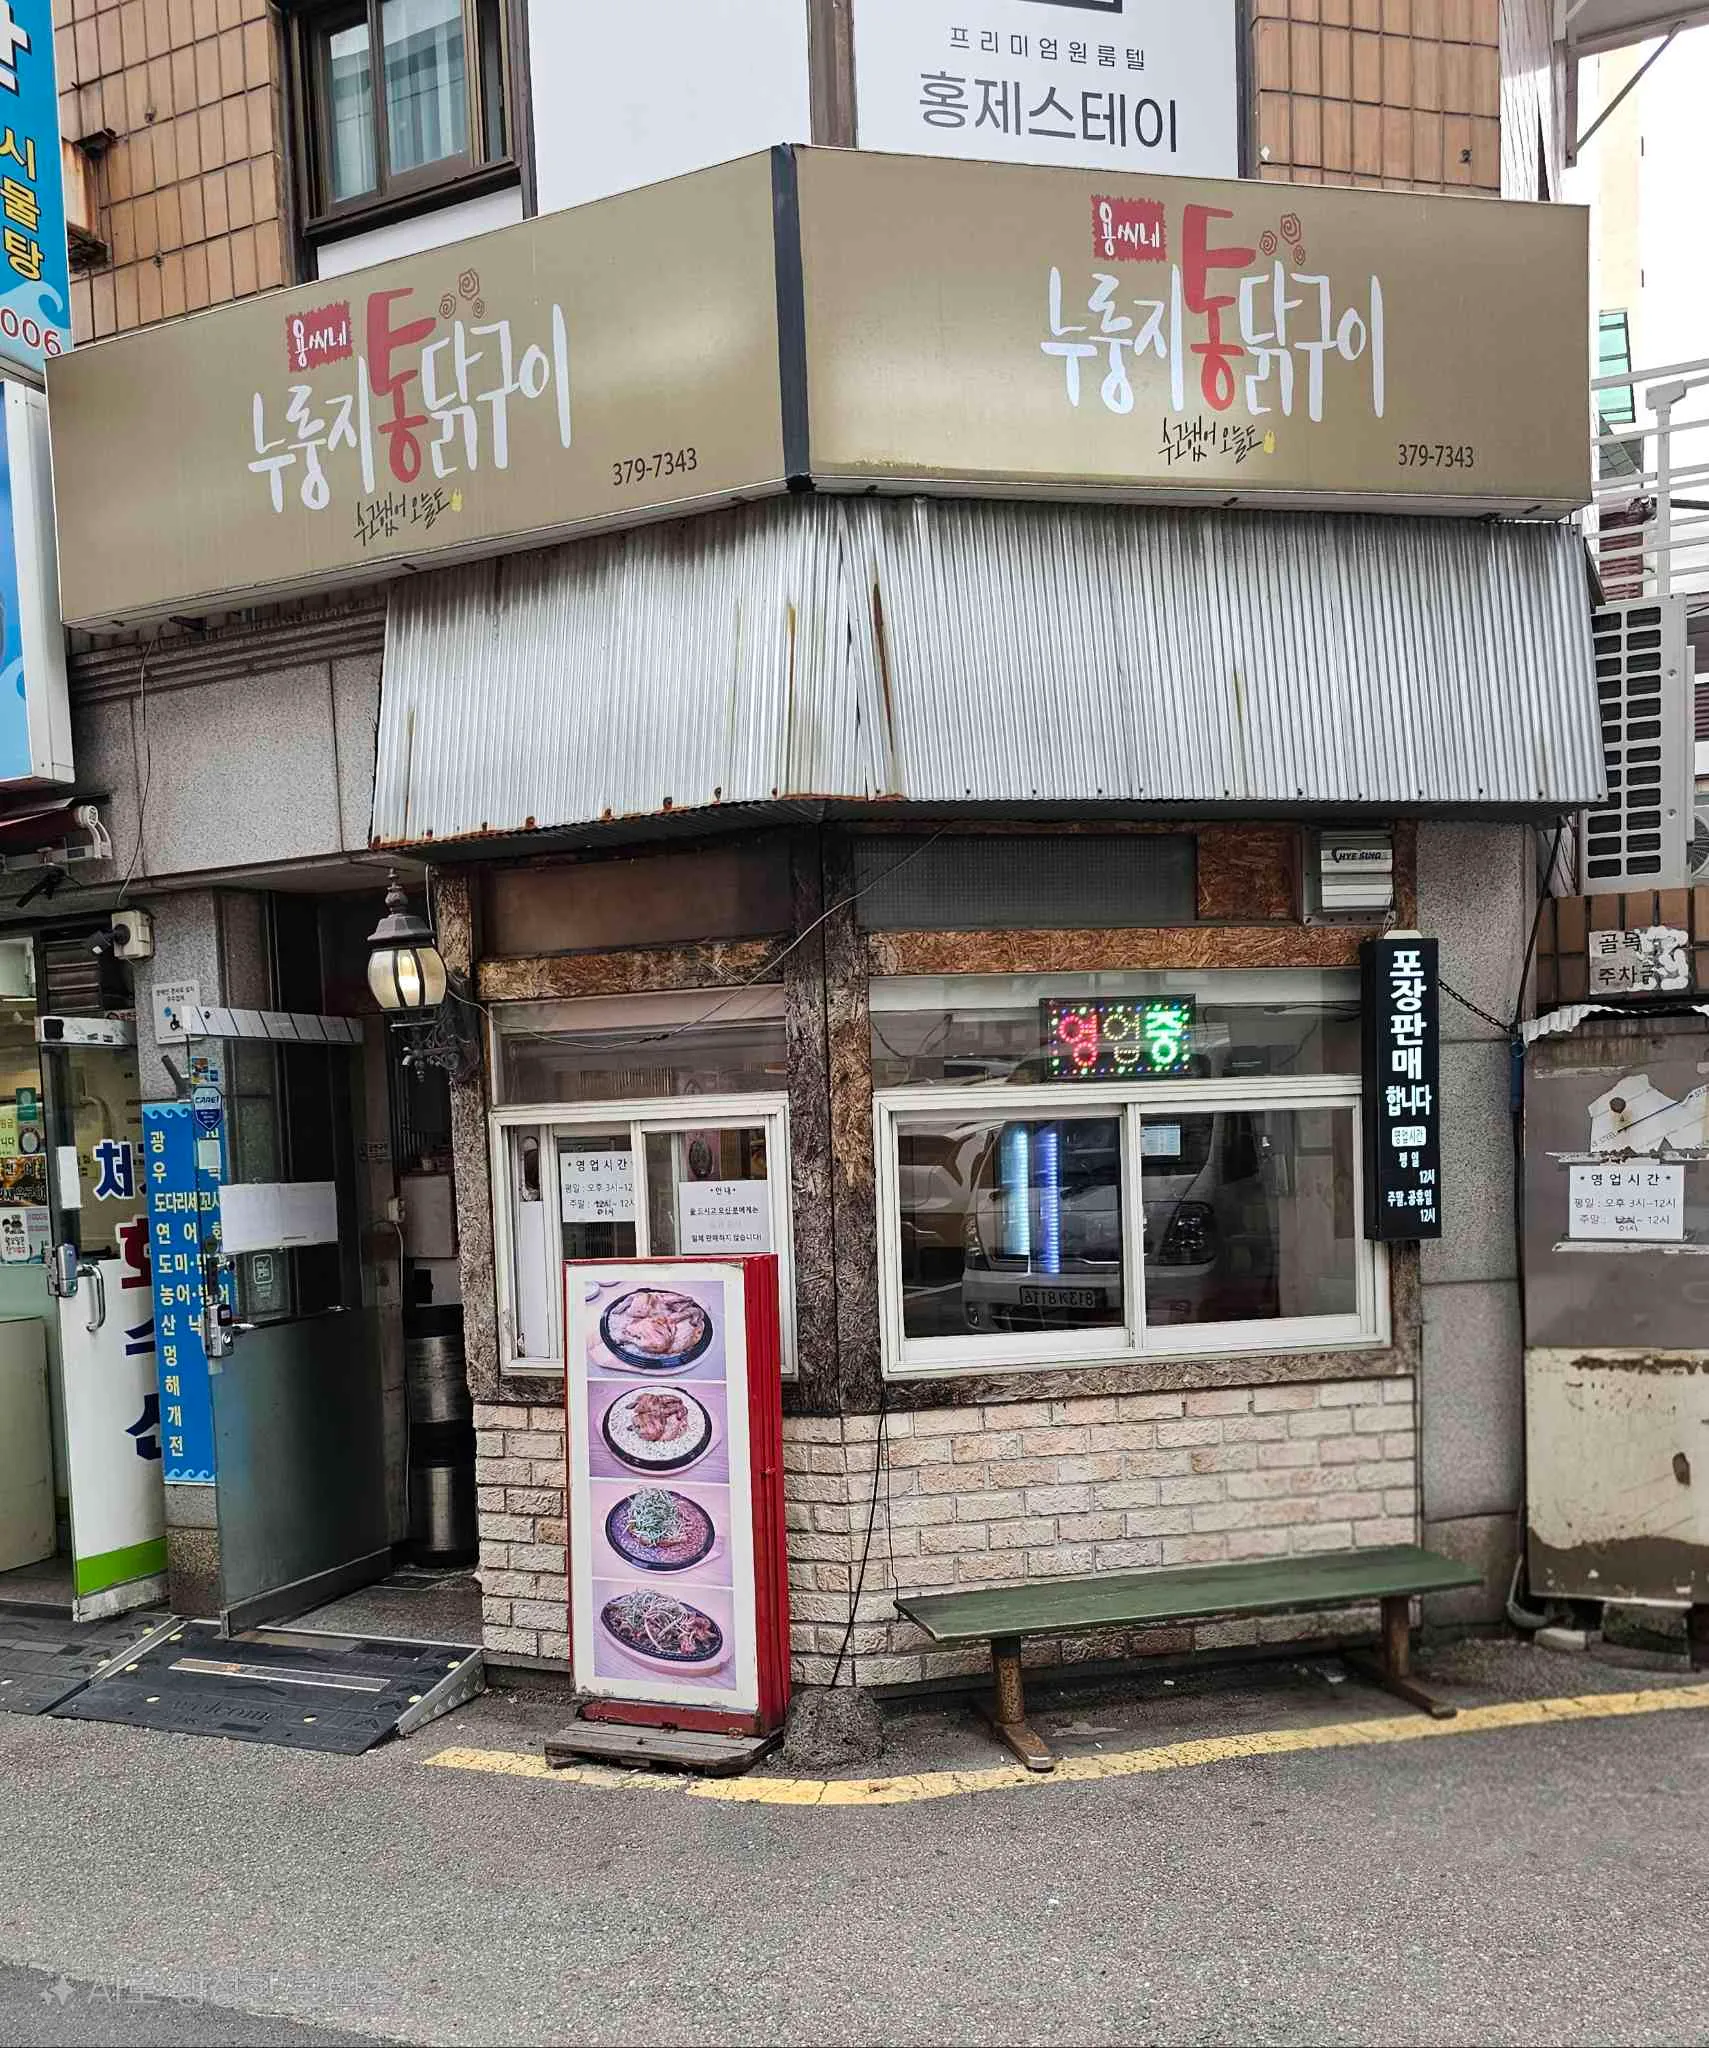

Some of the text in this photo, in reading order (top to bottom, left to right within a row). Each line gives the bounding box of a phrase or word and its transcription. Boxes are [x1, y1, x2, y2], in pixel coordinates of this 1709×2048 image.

[919, 71, 1177, 153] 홍제스테이
[612, 447, 698, 486] 379-7343
[1398, 444, 1474, 469] 379-7343
[1390, 950, 1427, 1080] 포장판매
[1059, 1010, 1184, 1067] 영업중
[1385, 1084, 1432, 1117] 합니다
[1419, 1168, 1435, 1185] 12시
[1420, 1207, 1436, 1223] 12시
